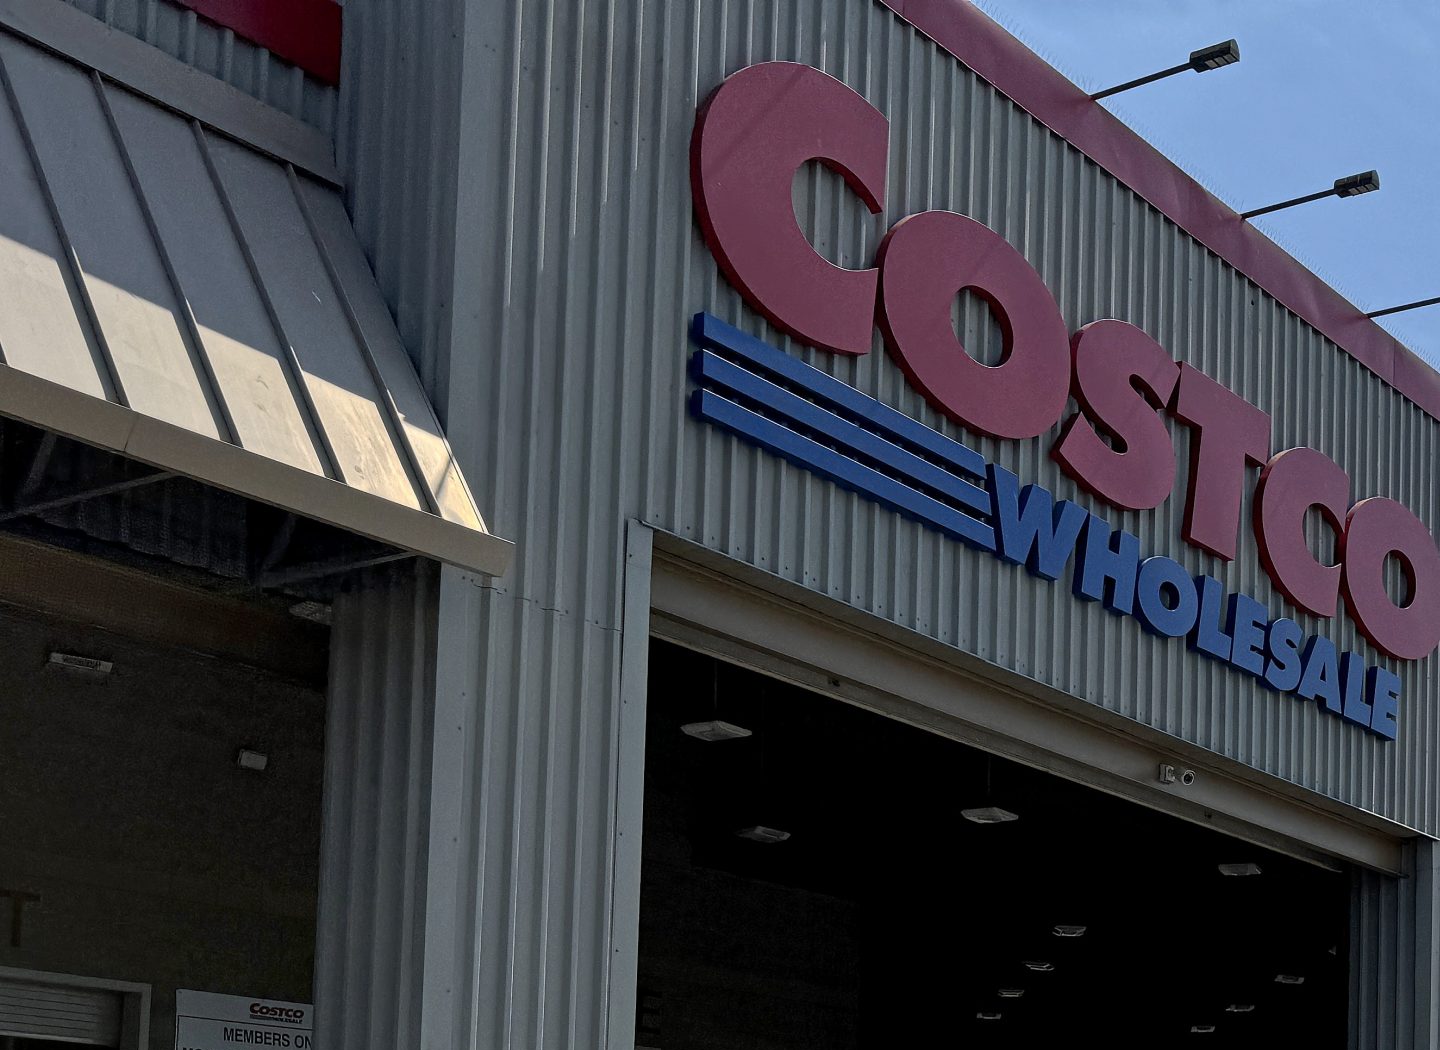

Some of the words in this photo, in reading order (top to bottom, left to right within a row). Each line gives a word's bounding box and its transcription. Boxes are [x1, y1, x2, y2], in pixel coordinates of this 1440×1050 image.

[986, 463, 1402, 742] WHOLESALE
[250, 1003, 304, 1019] COSTCO
[223, 1027, 290, 1048] MEMBERS
